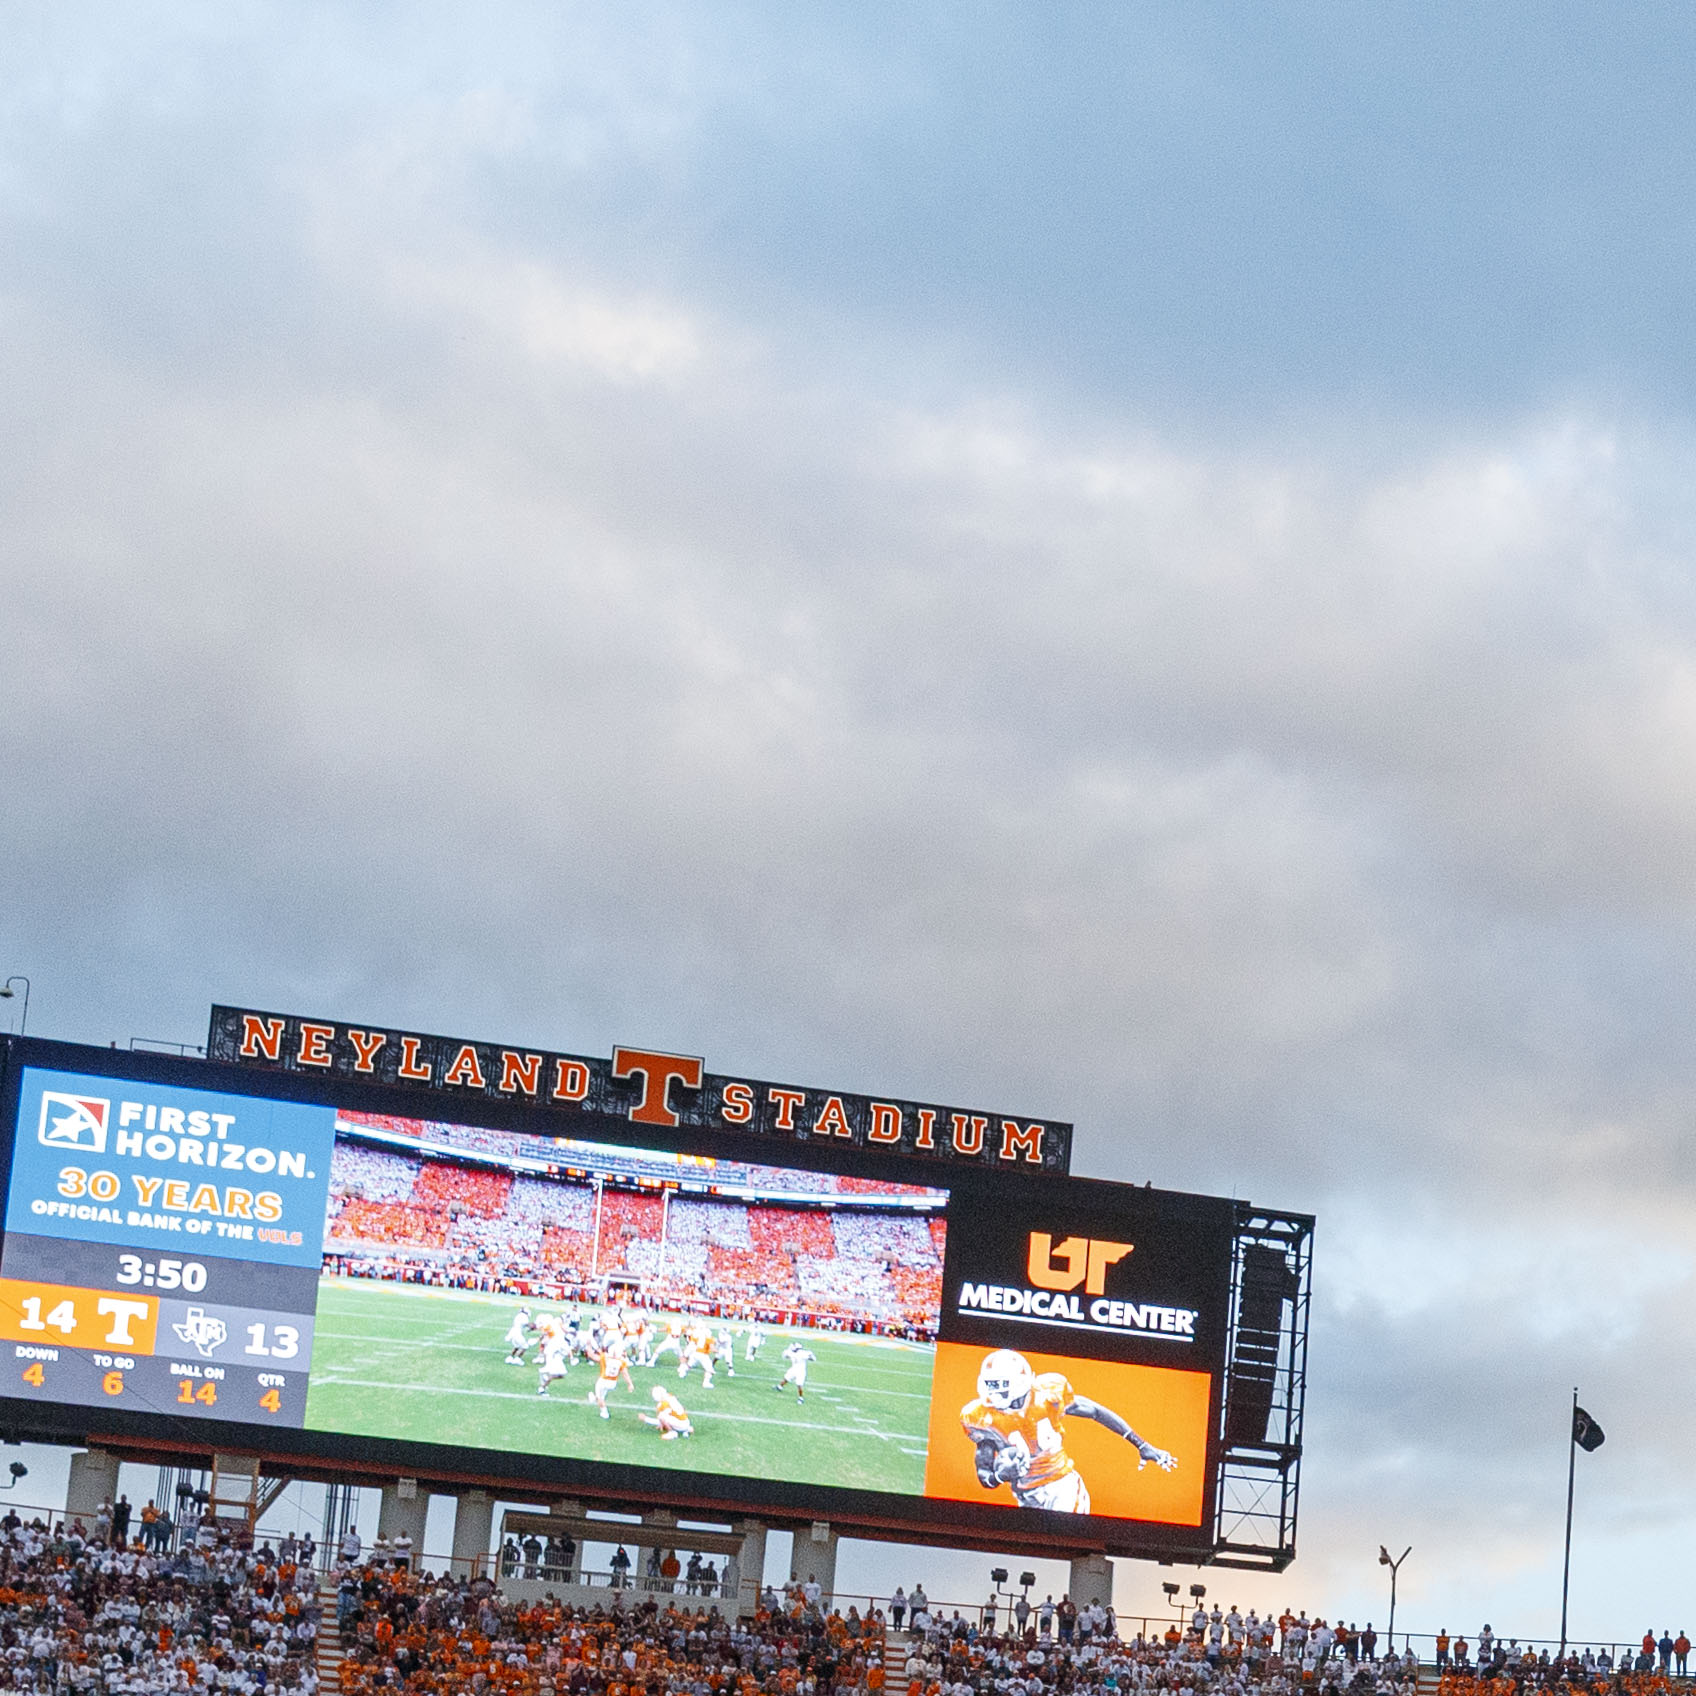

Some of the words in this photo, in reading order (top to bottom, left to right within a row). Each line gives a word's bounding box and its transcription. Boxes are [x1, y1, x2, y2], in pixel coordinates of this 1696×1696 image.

[240, 1014, 591, 1102] NEYLAND
[611, 1046, 704, 1127] T
[721, 1083, 1046, 1164] STADIUM
[120, 1101, 236, 1139] FIRST
[116, 1130, 316, 1179] HORIZON.
[57, 1166, 121, 1201] 30
[132, 1175, 283, 1222] YEARS
[31, 1199, 123, 1224] OFFICIAL
[127, 1211, 182, 1231] BANK
[185, 1218, 212, 1235] OF
[216, 1222, 254, 1240] THE
[116, 1254, 208, 1293] 3:50
[20, 1297, 77, 1334] 14
[97, 1297, 149, 1346] T
[959, 1282, 1085, 1321] MEDICAL
[1090, 1299, 1197, 1334] CENTER
[15, 1345, 59, 1362] DOWN
[244, 1323, 300, 1359] 13
[22, 1362, 45, 1387] 4
[93, 1354, 112, 1367] TO
[114, 1356, 135, 1370] GO
[170, 1362, 203, 1378] BALL
[204, 1366, 225, 1380] ON
[258, 1373, 286, 1387] QTR
[102, 1371, 124, 1396] 6
[177, 1379, 218, 1406] 14
[259, 1388, 281, 1413] 4
